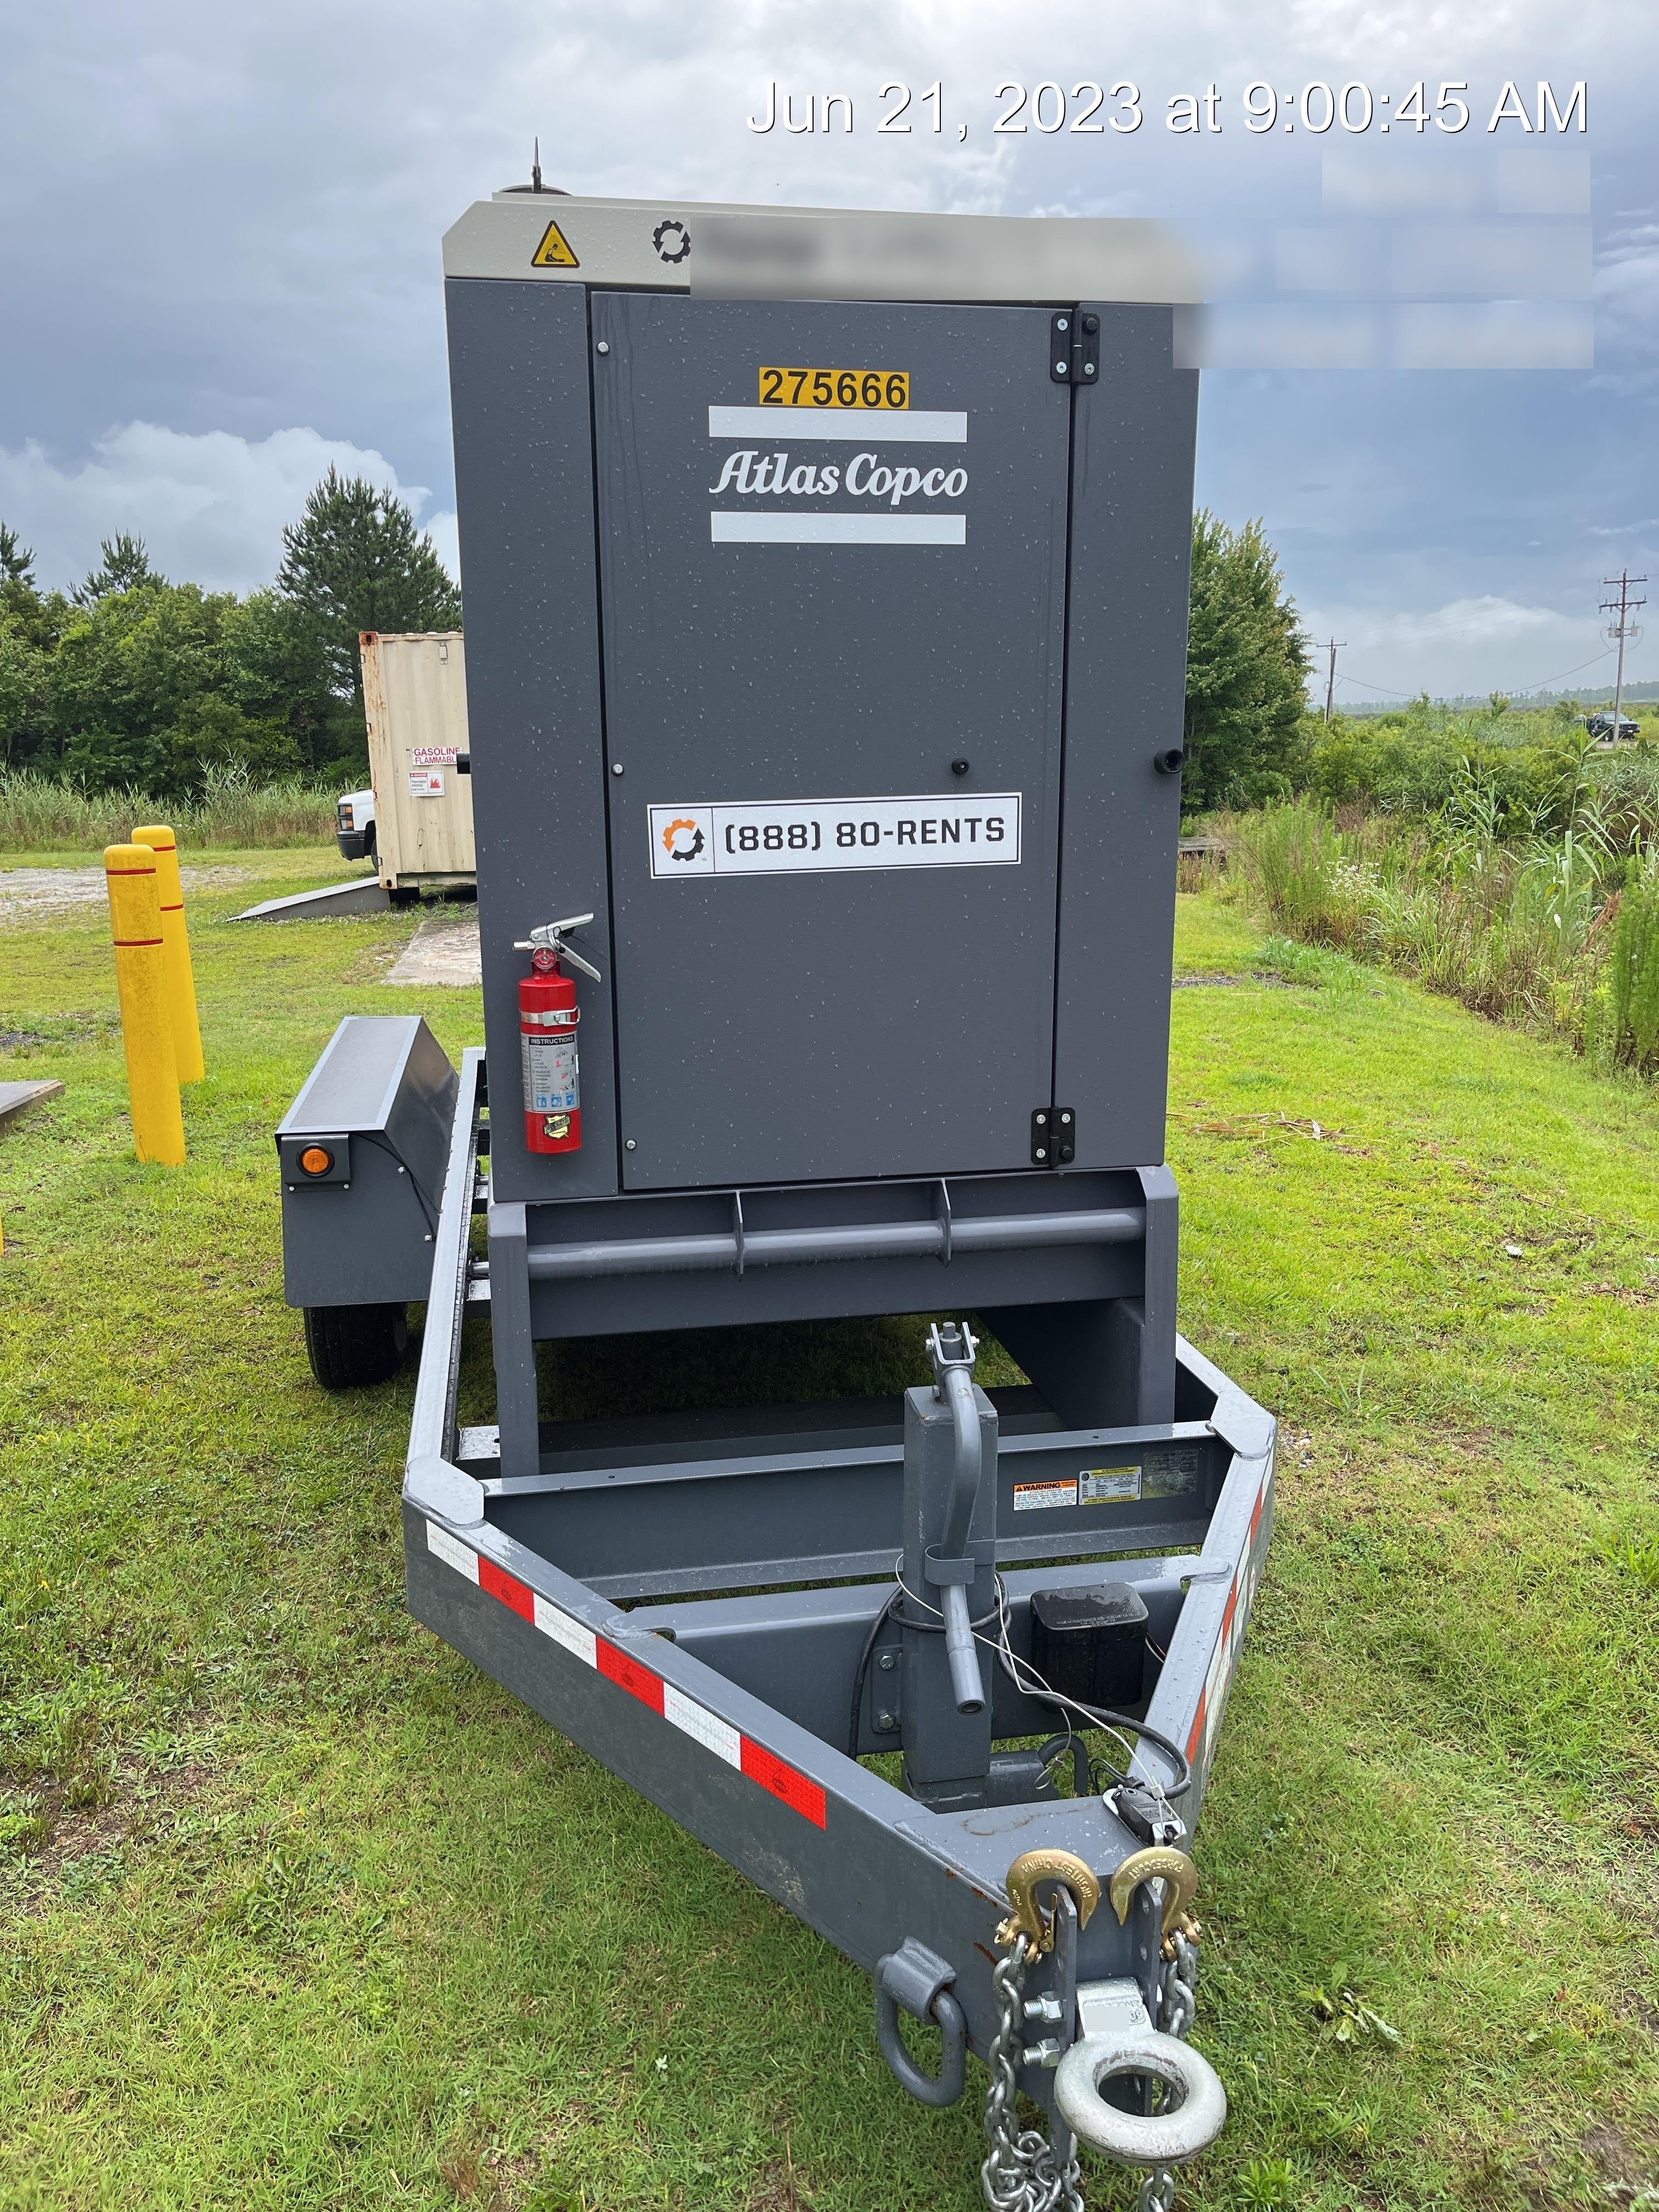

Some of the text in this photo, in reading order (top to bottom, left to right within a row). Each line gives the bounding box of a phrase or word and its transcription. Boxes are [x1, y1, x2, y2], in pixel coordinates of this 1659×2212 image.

[762, 369, 906, 408] 275666
[709, 450, 968, 506] Atlas Copco
[414, 747, 461, 756] GASOLINE
[415, 756, 457, 764] FLAMMABL
[725, 817, 1005, 854] (888) 80-RENTS
[531, 1035, 574, 1045] INSTRUCTIONS
[1023, 1482, 1060, 1491] WARNING
